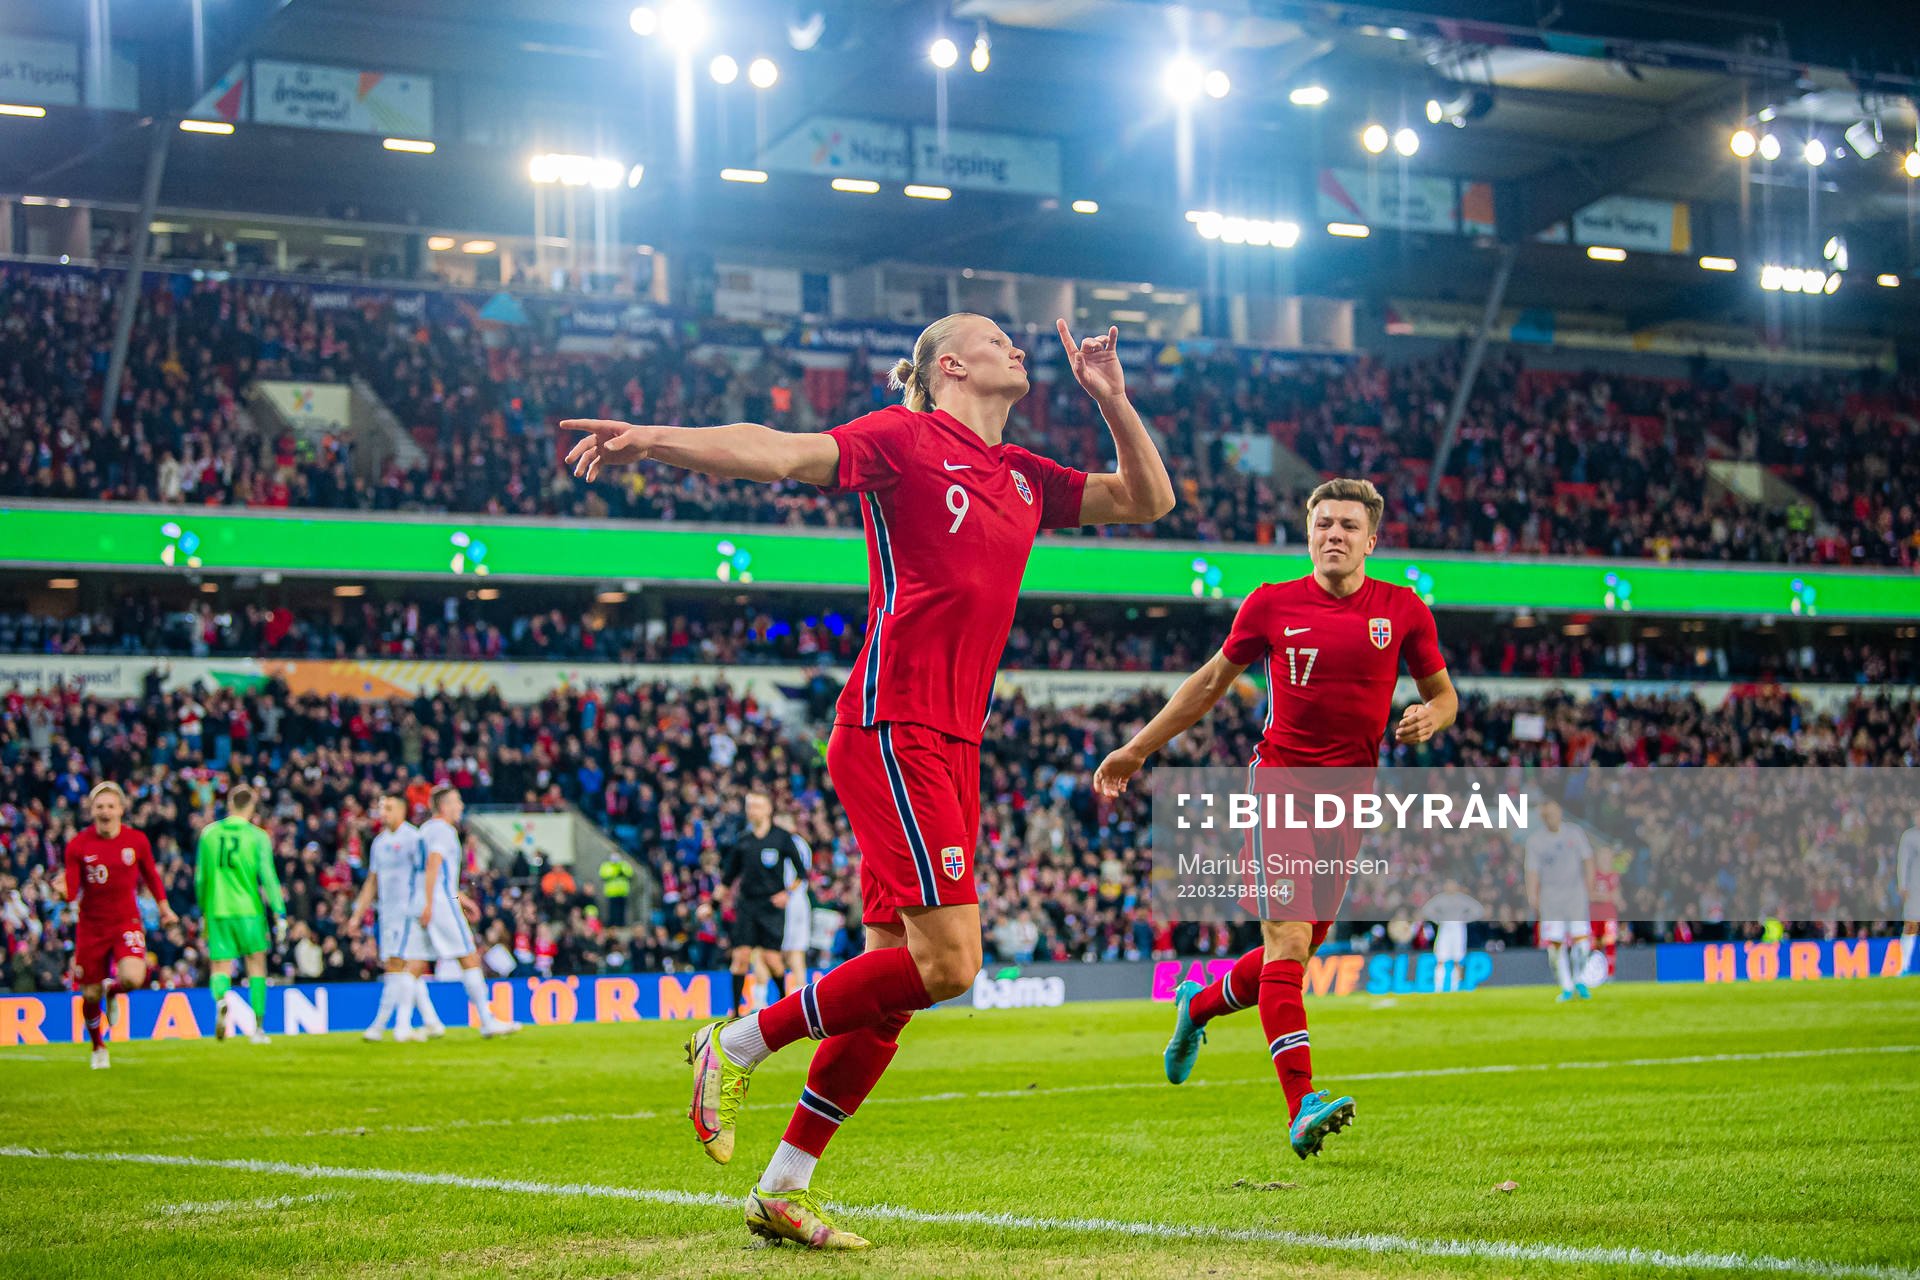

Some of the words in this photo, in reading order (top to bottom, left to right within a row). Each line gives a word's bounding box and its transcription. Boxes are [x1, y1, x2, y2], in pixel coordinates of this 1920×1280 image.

[945, 484, 970, 534] 9
[1285, 646, 1319, 687] 17
[219, 835, 241, 869] 12
[973, 968, 1065, 1010] bama
